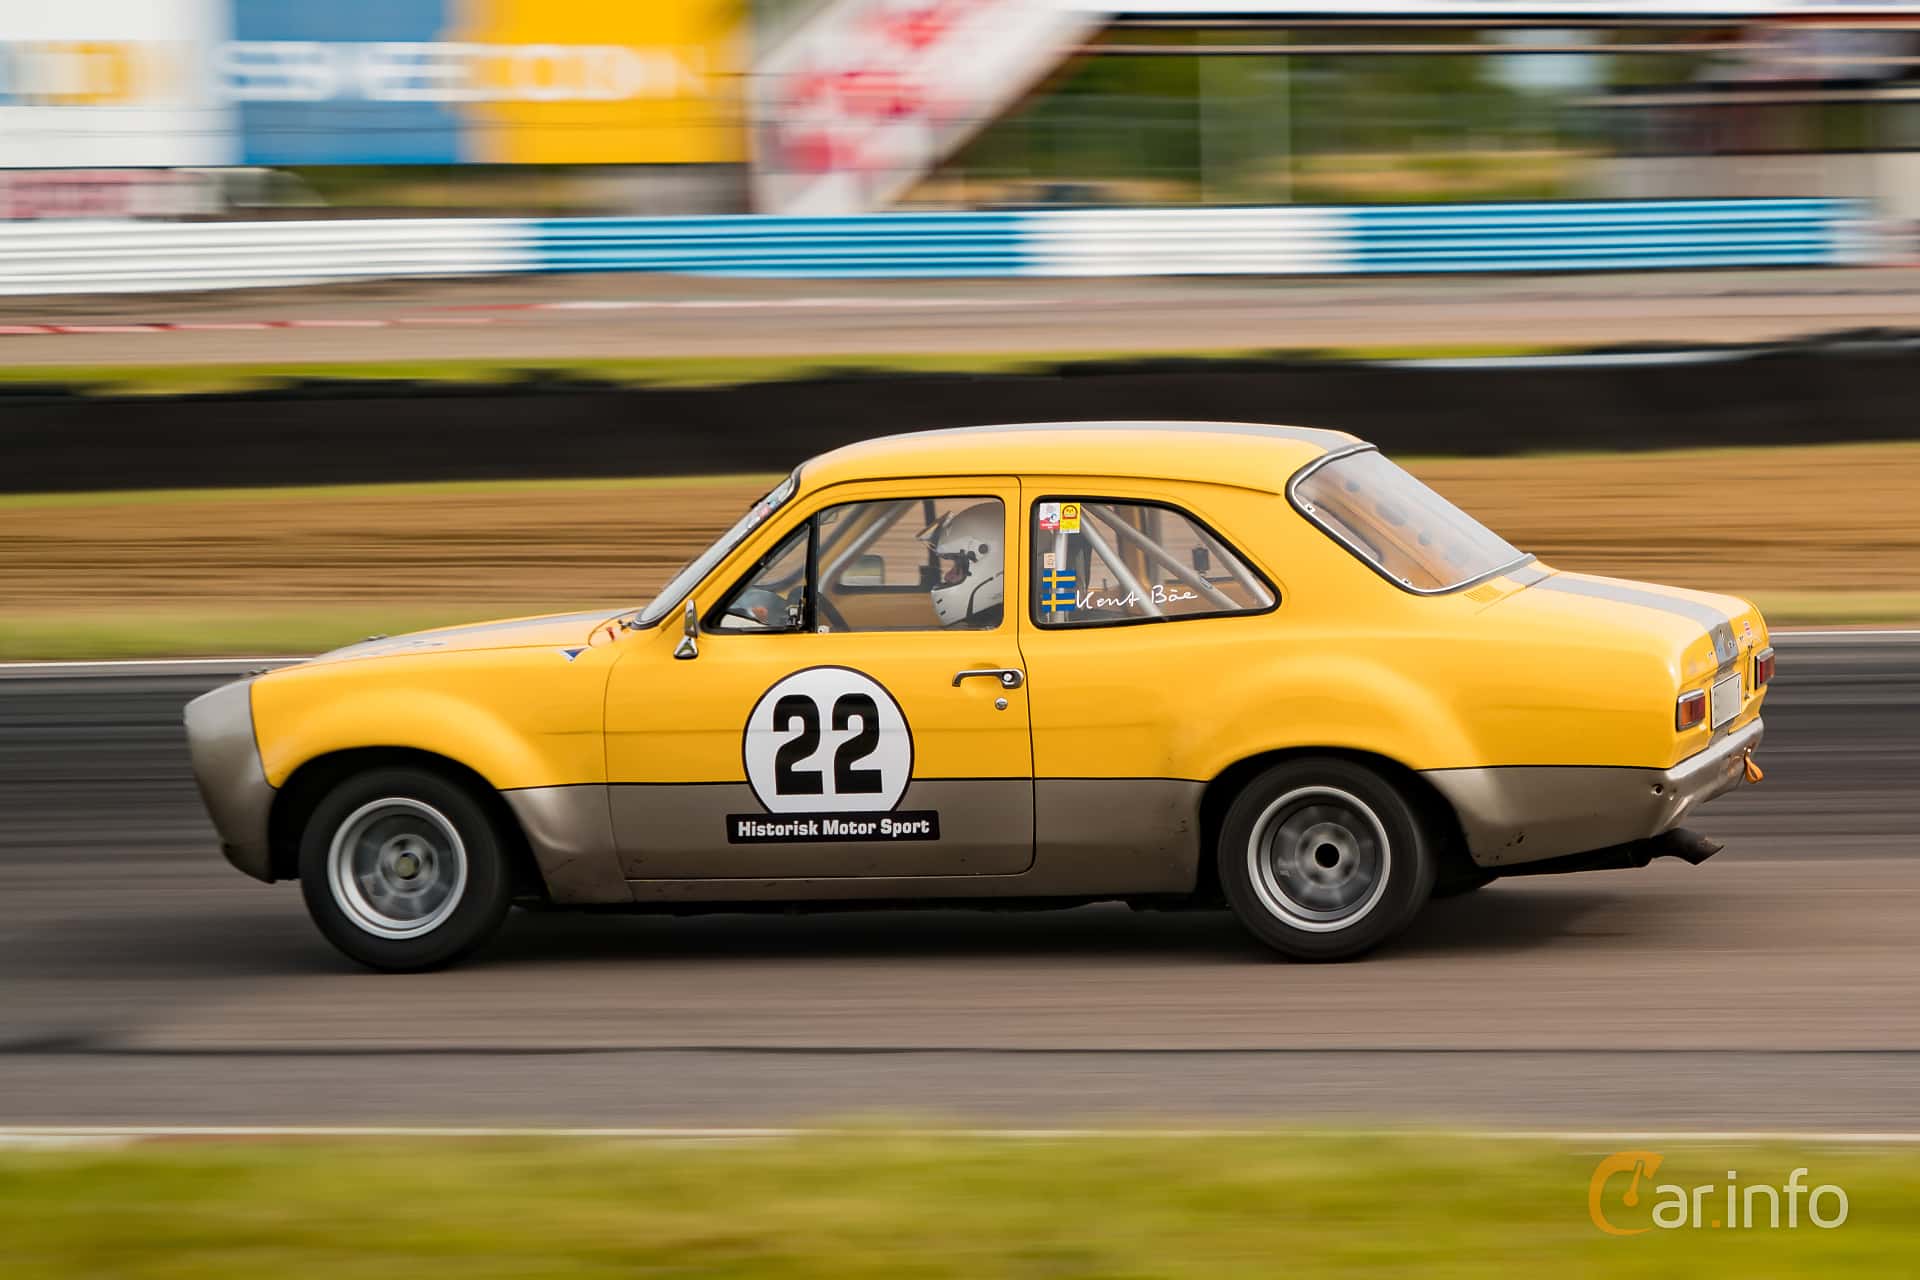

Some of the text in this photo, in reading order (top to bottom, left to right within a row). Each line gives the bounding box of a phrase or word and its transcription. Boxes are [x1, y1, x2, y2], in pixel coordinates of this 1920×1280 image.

[773, 693, 883, 795] 22
[737, 818, 931, 838] Historisk Motor Sport
